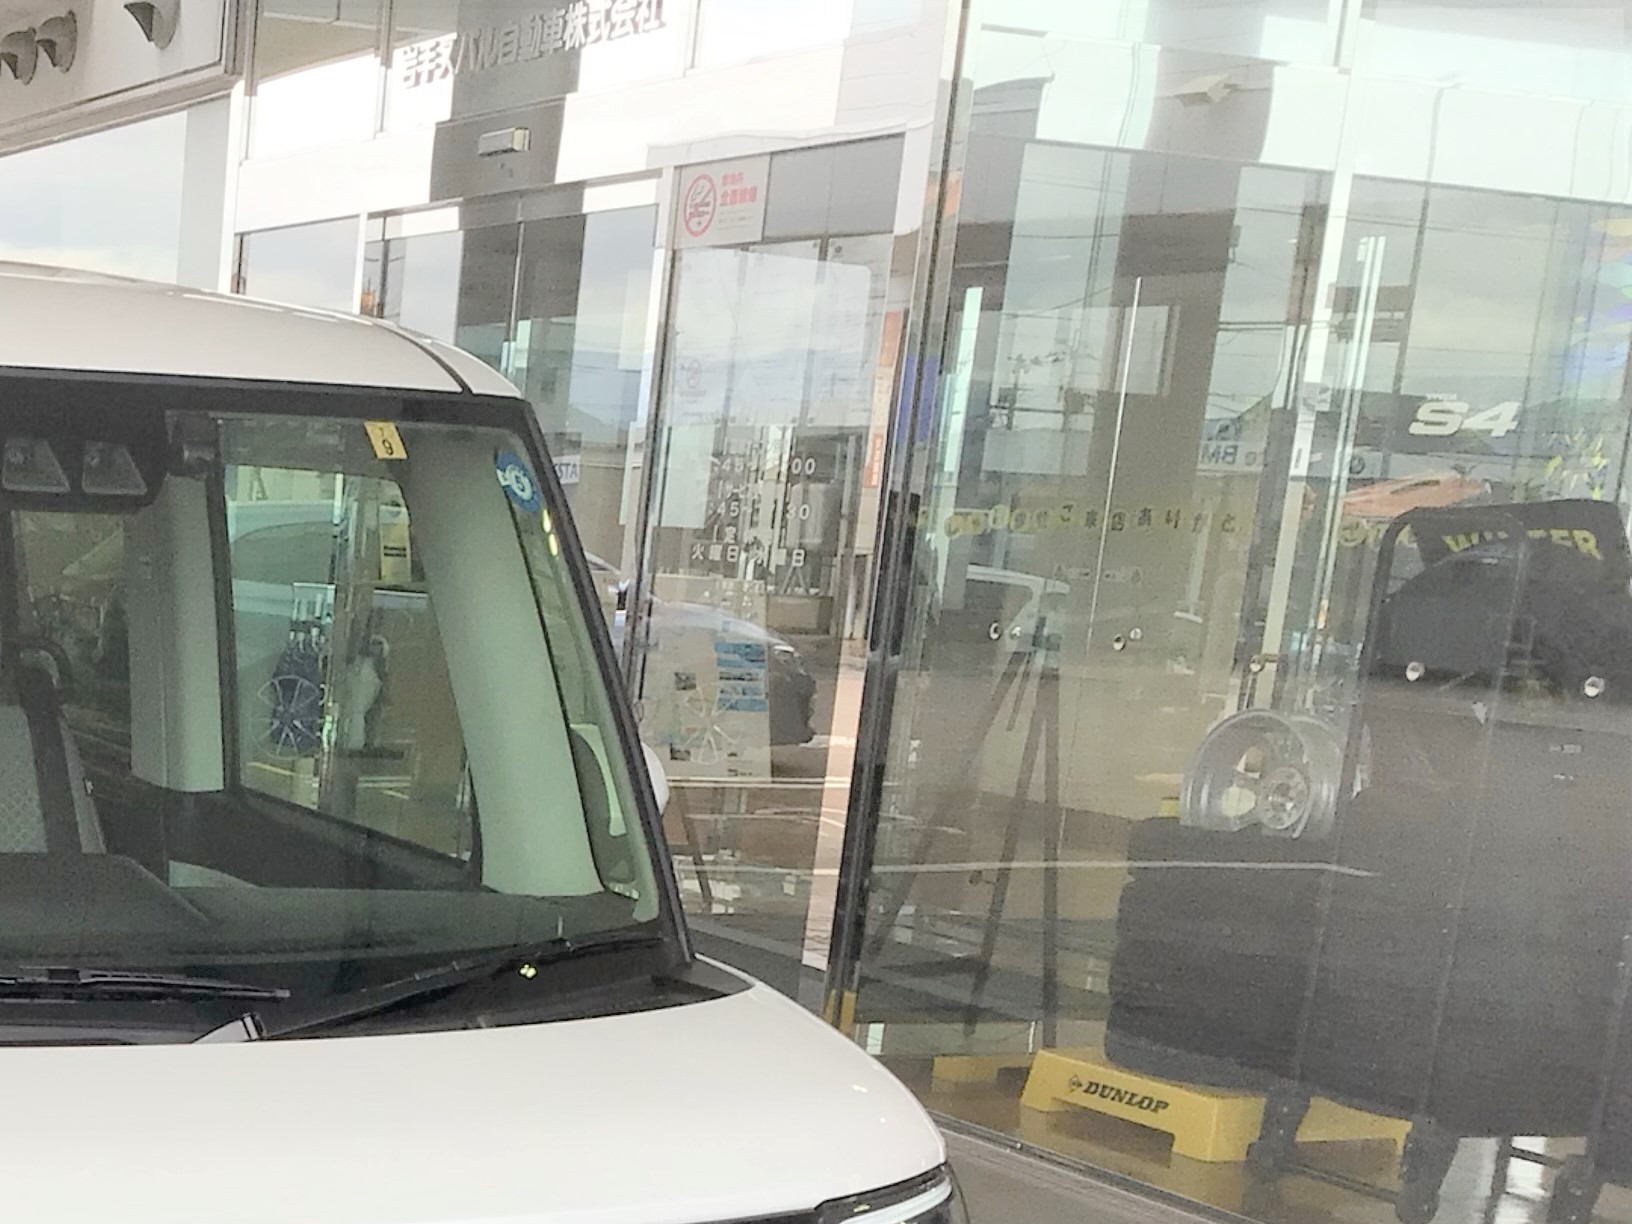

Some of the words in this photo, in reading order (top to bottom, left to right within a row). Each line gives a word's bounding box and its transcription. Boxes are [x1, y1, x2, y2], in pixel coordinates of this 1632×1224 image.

[1408, 401, 1521, 437] S4
[382, 438, 394, 456] 9
[1083, 1080, 1170, 1114] DUNLOP
